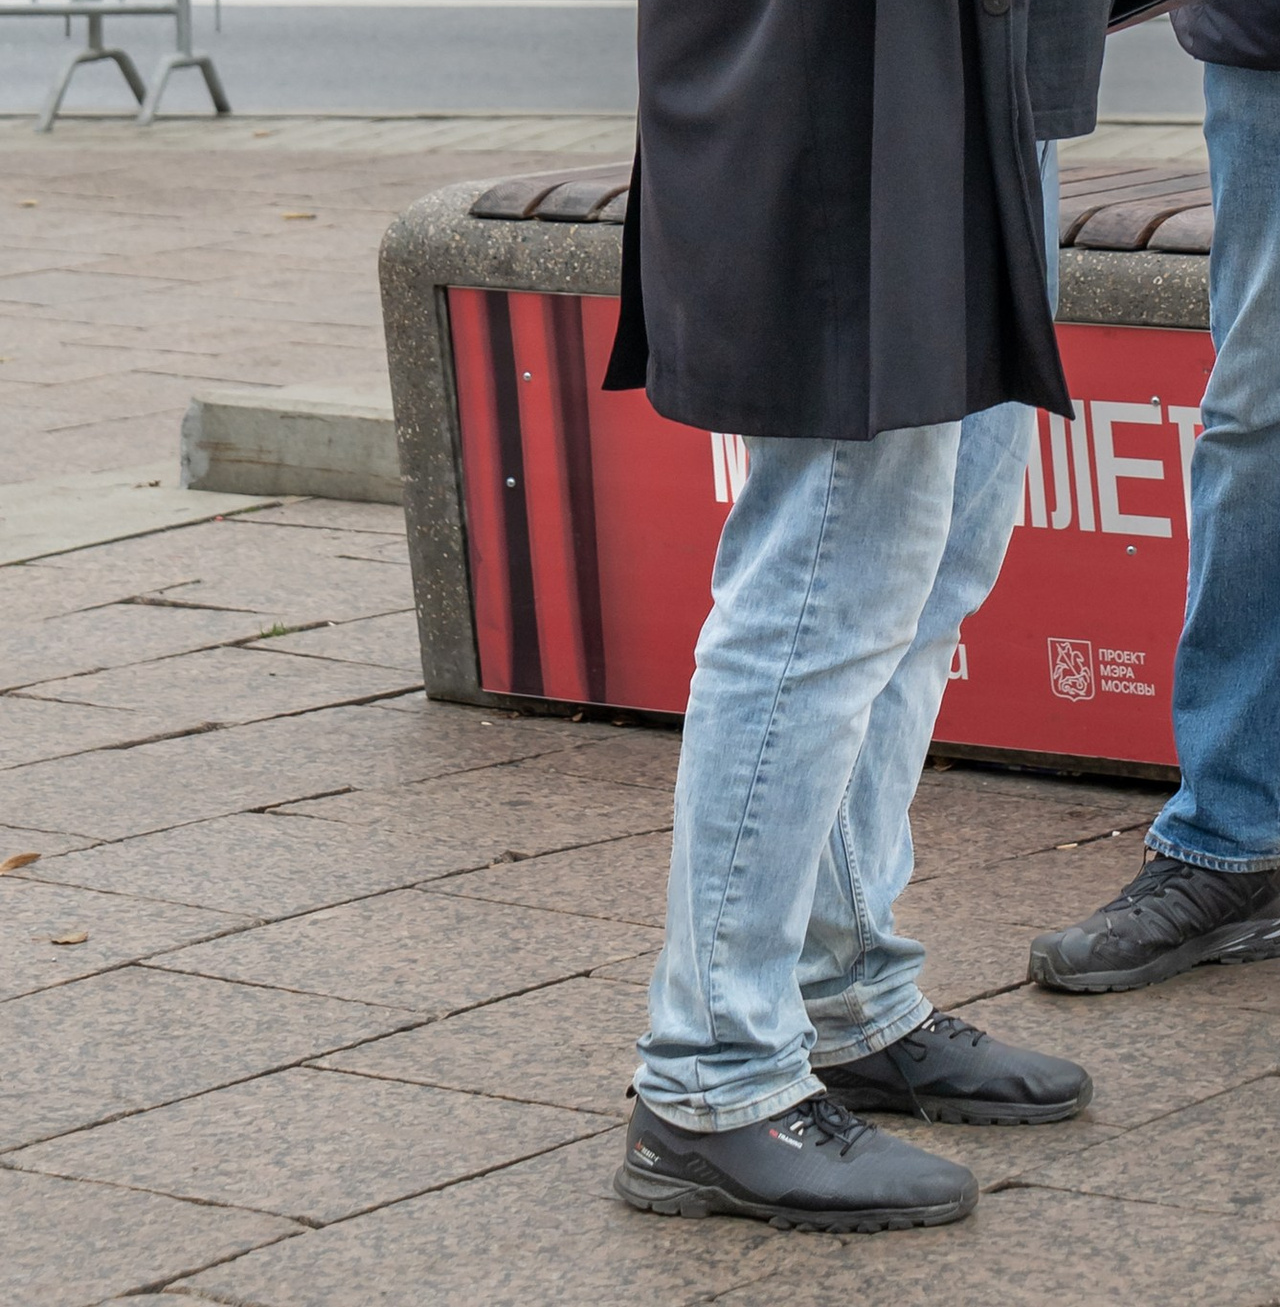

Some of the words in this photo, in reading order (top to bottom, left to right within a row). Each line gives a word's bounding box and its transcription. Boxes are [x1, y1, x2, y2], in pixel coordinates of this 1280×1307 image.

[1098, 648, 1146, 665] ПРОЕКТ
[1100, 663, 1135, 679] МЭРА
[1101, 679, 1156, 696] МОСКВЫ
